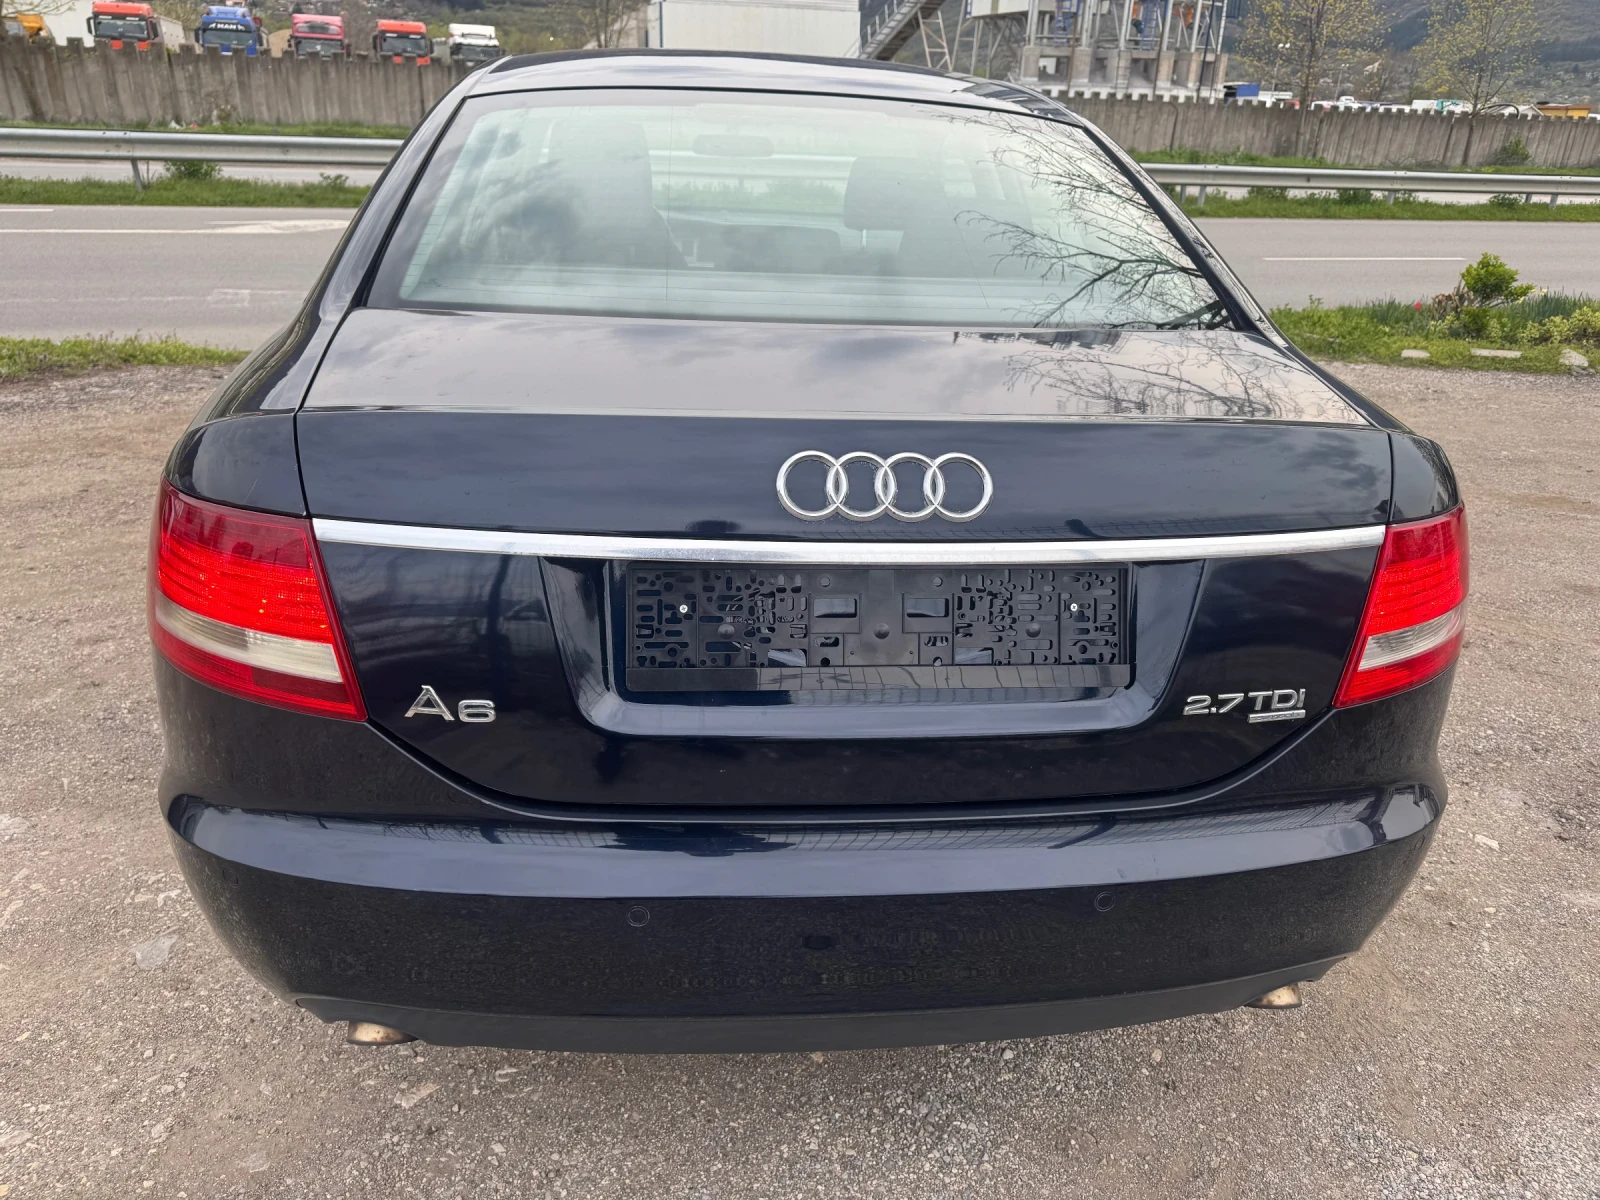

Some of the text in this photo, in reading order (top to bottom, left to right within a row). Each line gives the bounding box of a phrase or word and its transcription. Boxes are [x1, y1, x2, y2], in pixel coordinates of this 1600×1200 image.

[404, 685, 496, 722] A6
[1183, 688, 1306, 715] 2.7 TDI
